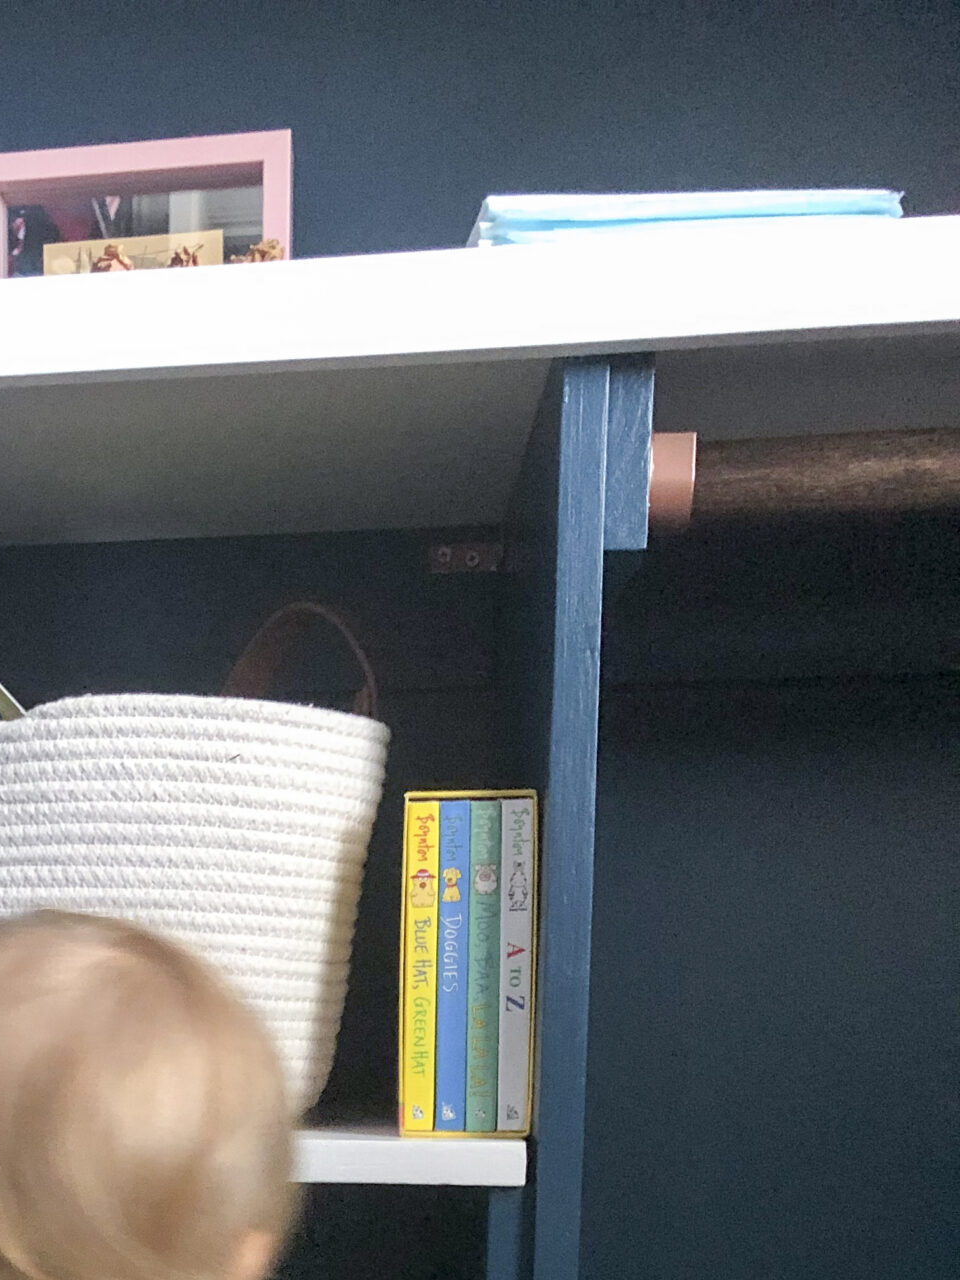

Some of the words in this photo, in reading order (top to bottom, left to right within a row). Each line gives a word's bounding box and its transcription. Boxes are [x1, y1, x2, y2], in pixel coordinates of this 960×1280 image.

[415, 814, 435, 862] Boynton
[445, 814, 464, 862] Boynton
[508, 808, 529, 857] Boynton
[414, 918, 432, 952] BLUE
[508, 944, 526, 958] A
[442, 914, 461, 992] DOGGIES
[412, 959, 433, 990] HAT,
[510, 967, 520, 987] TO
[505, 996, 525, 1011] Z
[413, 997, 432, 1047] GREEN
[413, 1051, 427, 1078] HAT
